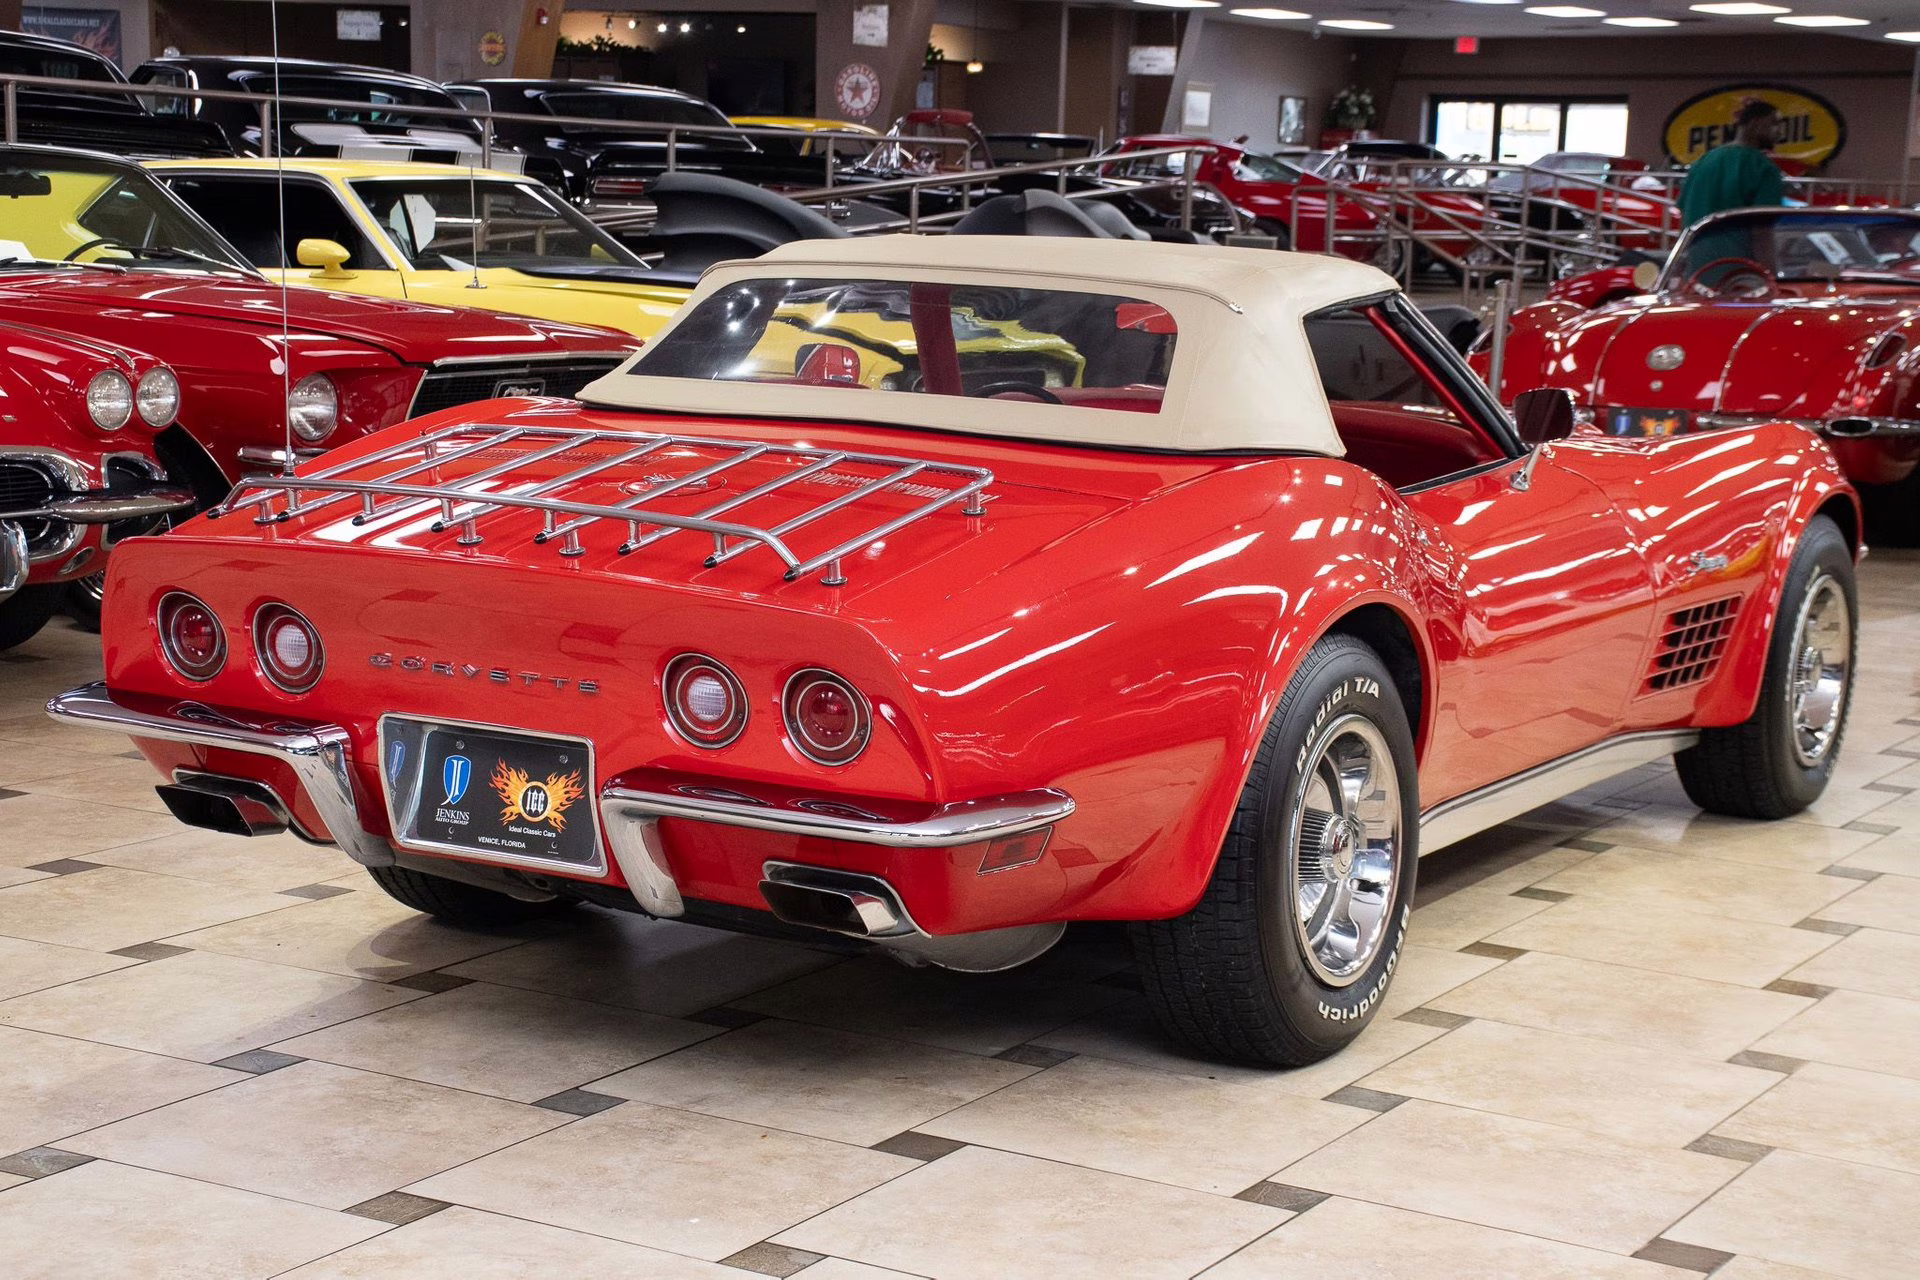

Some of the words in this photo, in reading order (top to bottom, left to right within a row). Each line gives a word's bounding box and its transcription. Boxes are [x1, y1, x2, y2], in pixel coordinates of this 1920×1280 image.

[370, 652, 599, 692] CORVETTE
[1296, 680, 1349, 775] Radial
[1354, 676, 1379, 699] T/A
[436, 807, 470, 821] JENKINS
[478, 836, 500, 846] VENICE,
[501, 839, 526, 849] FLORIDA
[508, 825, 522, 833] Ideal
[523, 827, 542, 837] Classic
[543, 830, 556, 838] Cars
[1318, 904, 1410, 1024] BFGoodrich
